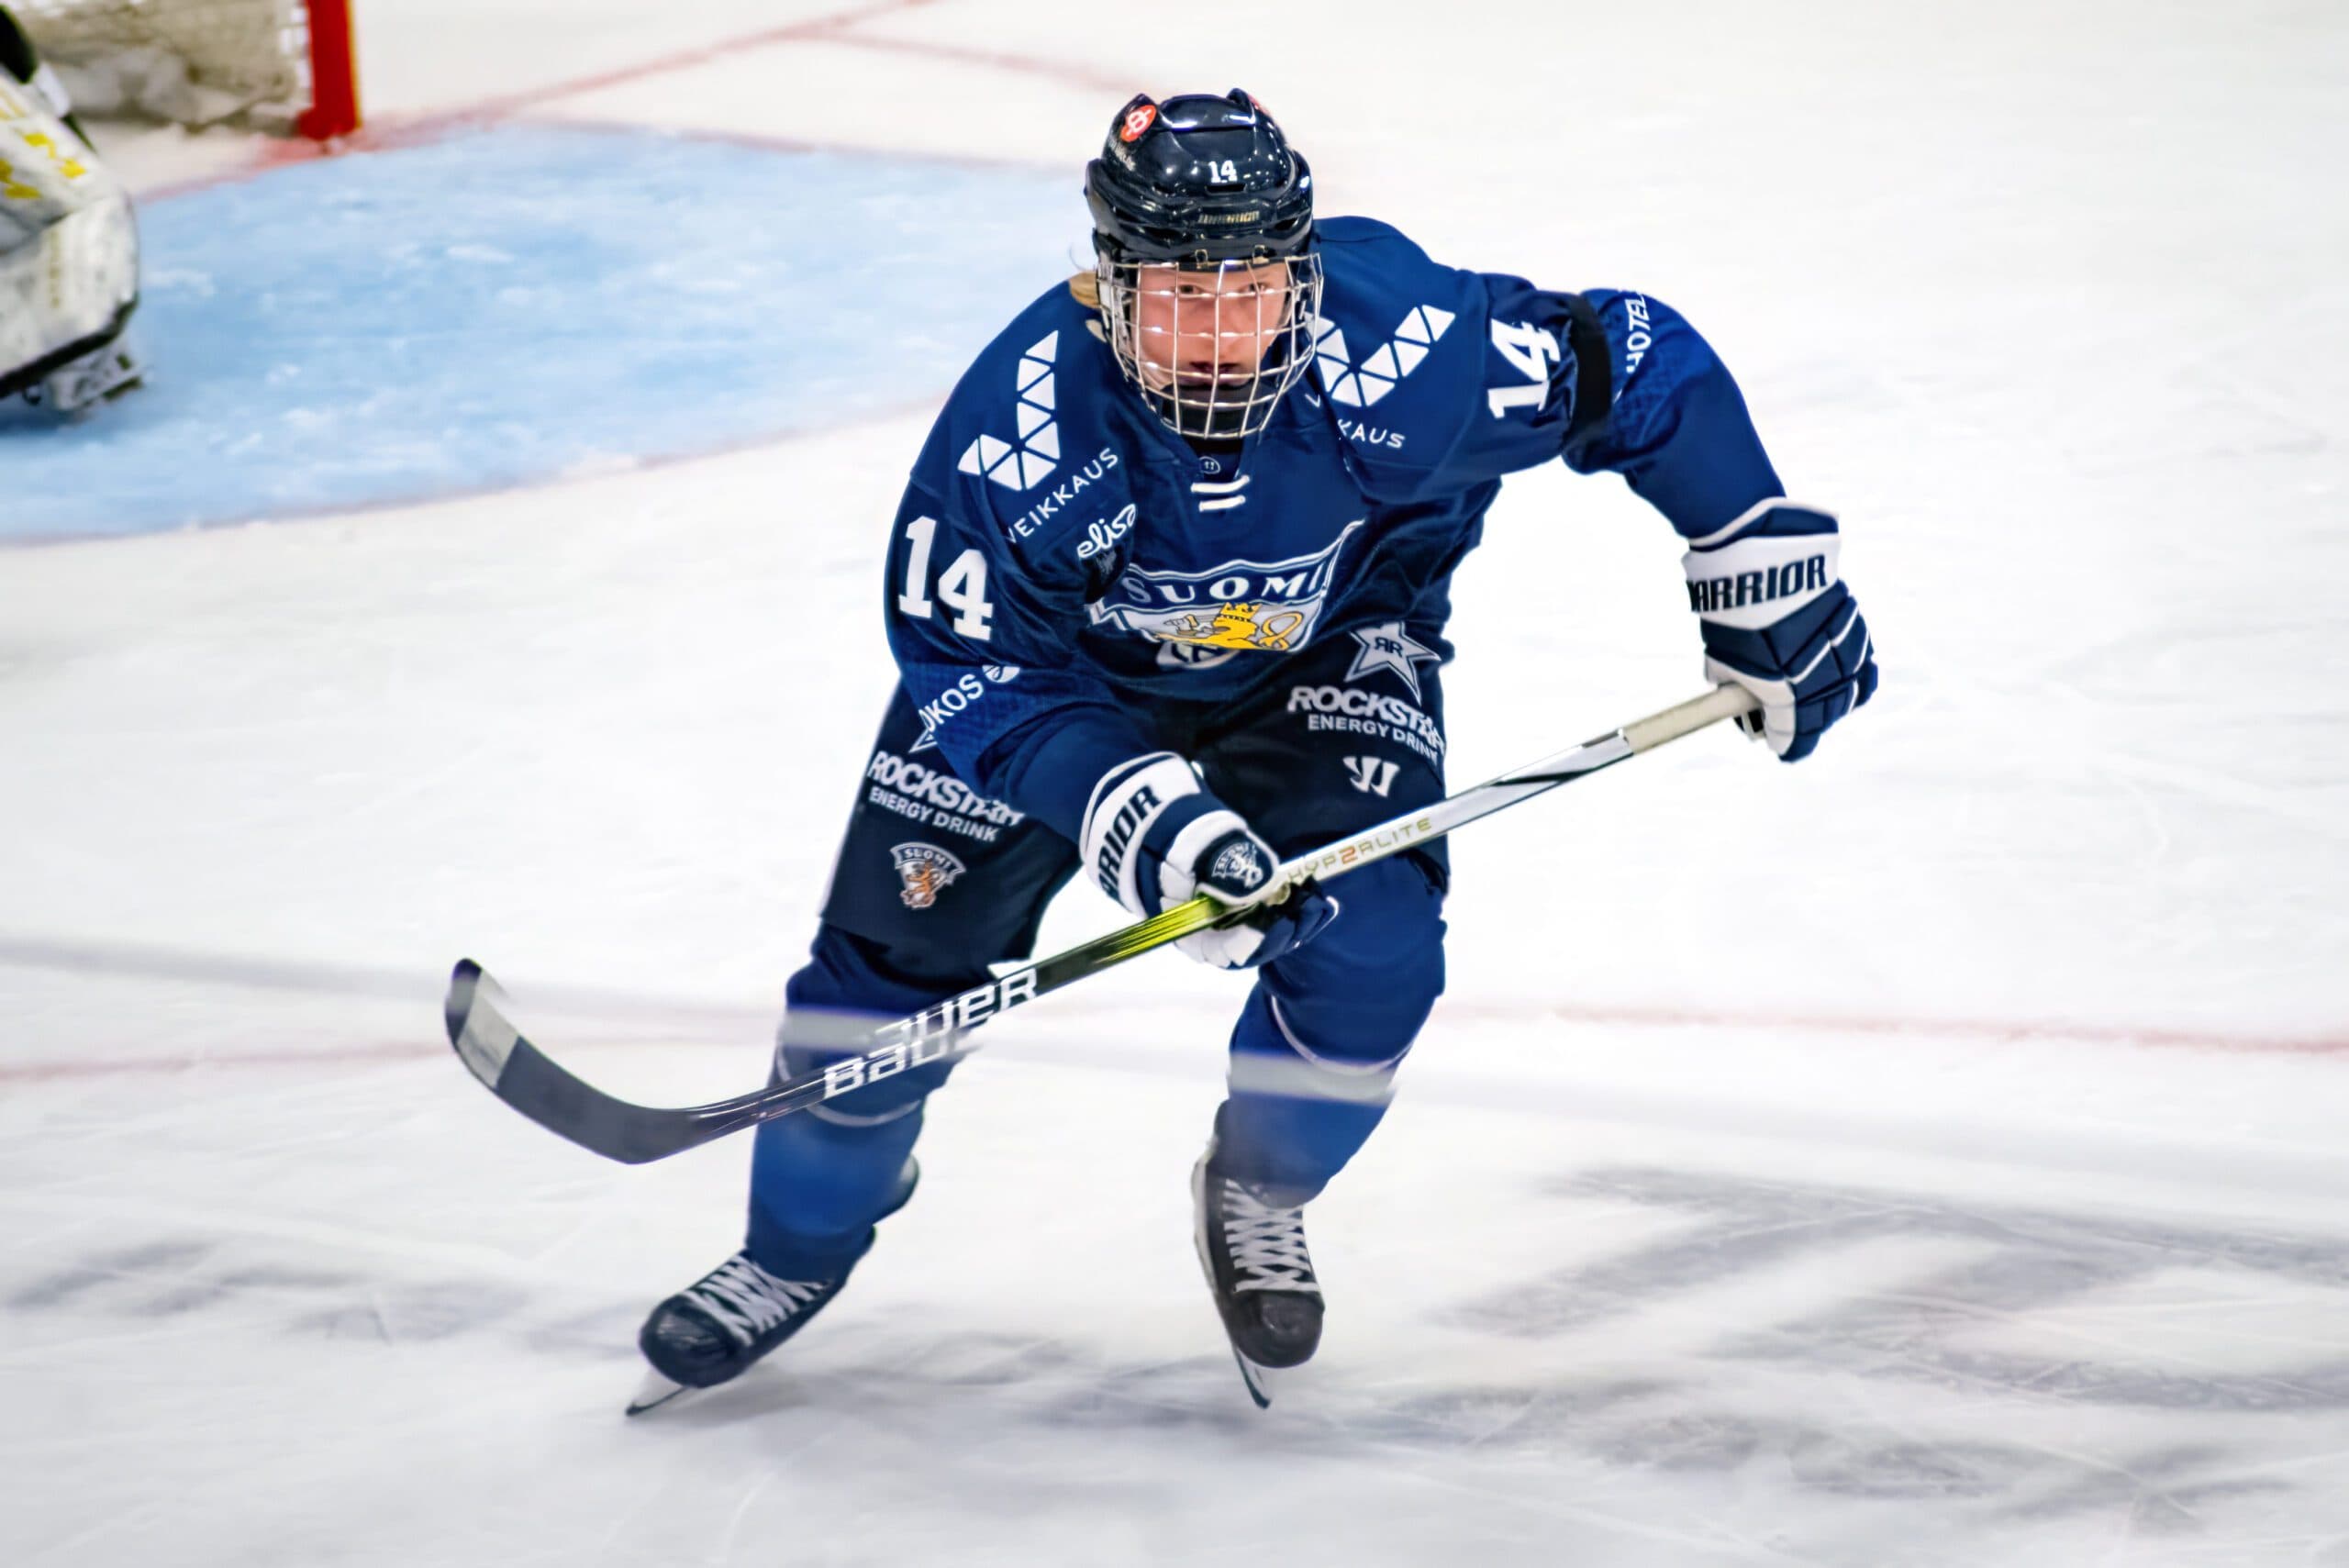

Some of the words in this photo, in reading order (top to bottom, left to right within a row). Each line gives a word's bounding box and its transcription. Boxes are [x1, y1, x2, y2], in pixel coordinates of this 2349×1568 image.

[1208, 160, 1238, 183] 14
[1487, 318, 1561, 418] 14
[1624, 292, 1652, 374] HOTEL
[1007, 447, 1119, 544] VEIKKAUS
[898, 516, 993, 640] 14
[1121, 563, 1325, 603] SUOMI
[1287, 685, 1446, 757] ROCKSTAR
[1308, 714, 1389, 739] ENERGY
[1392, 728, 1438, 767] DRINK
[869, 785, 934, 822] ENERGY
[932, 810, 999, 842] DRINK
